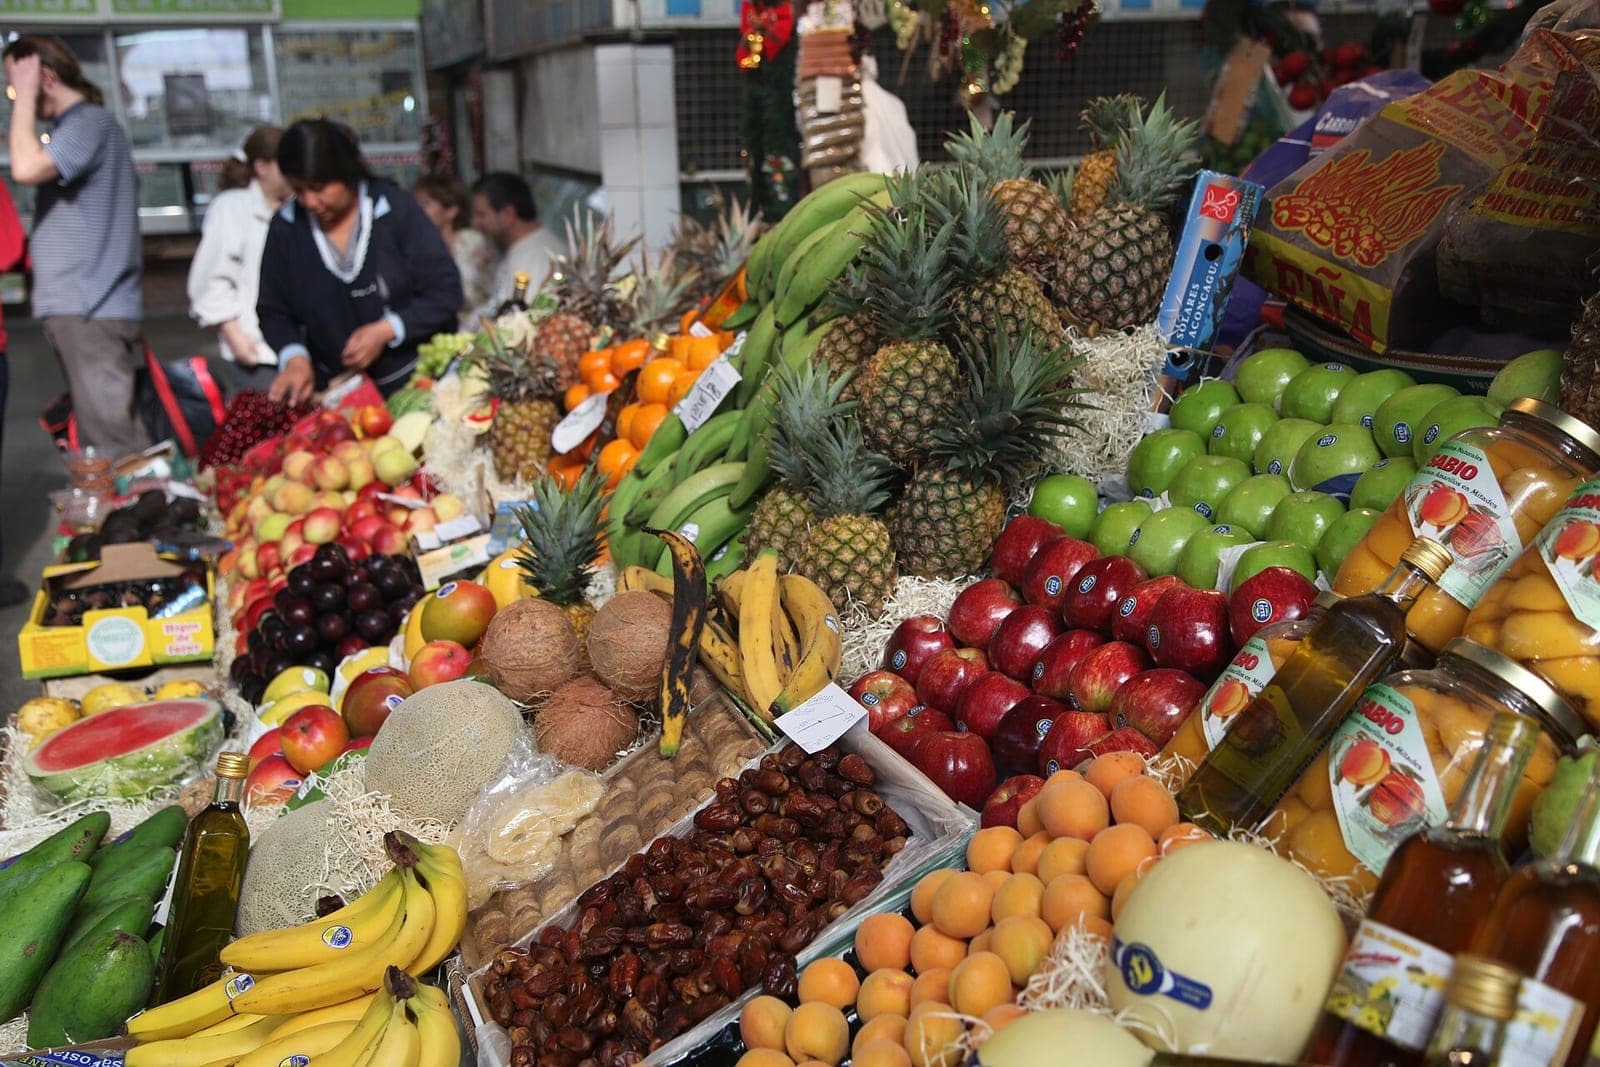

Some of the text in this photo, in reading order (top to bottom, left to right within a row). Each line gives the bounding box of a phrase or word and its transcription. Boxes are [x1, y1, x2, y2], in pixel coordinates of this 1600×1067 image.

[1177, 283, 1200, 340] SOLARES
[1461, 484, 1470, 492] en
[1470, 488, 1498, 509] Mitades
